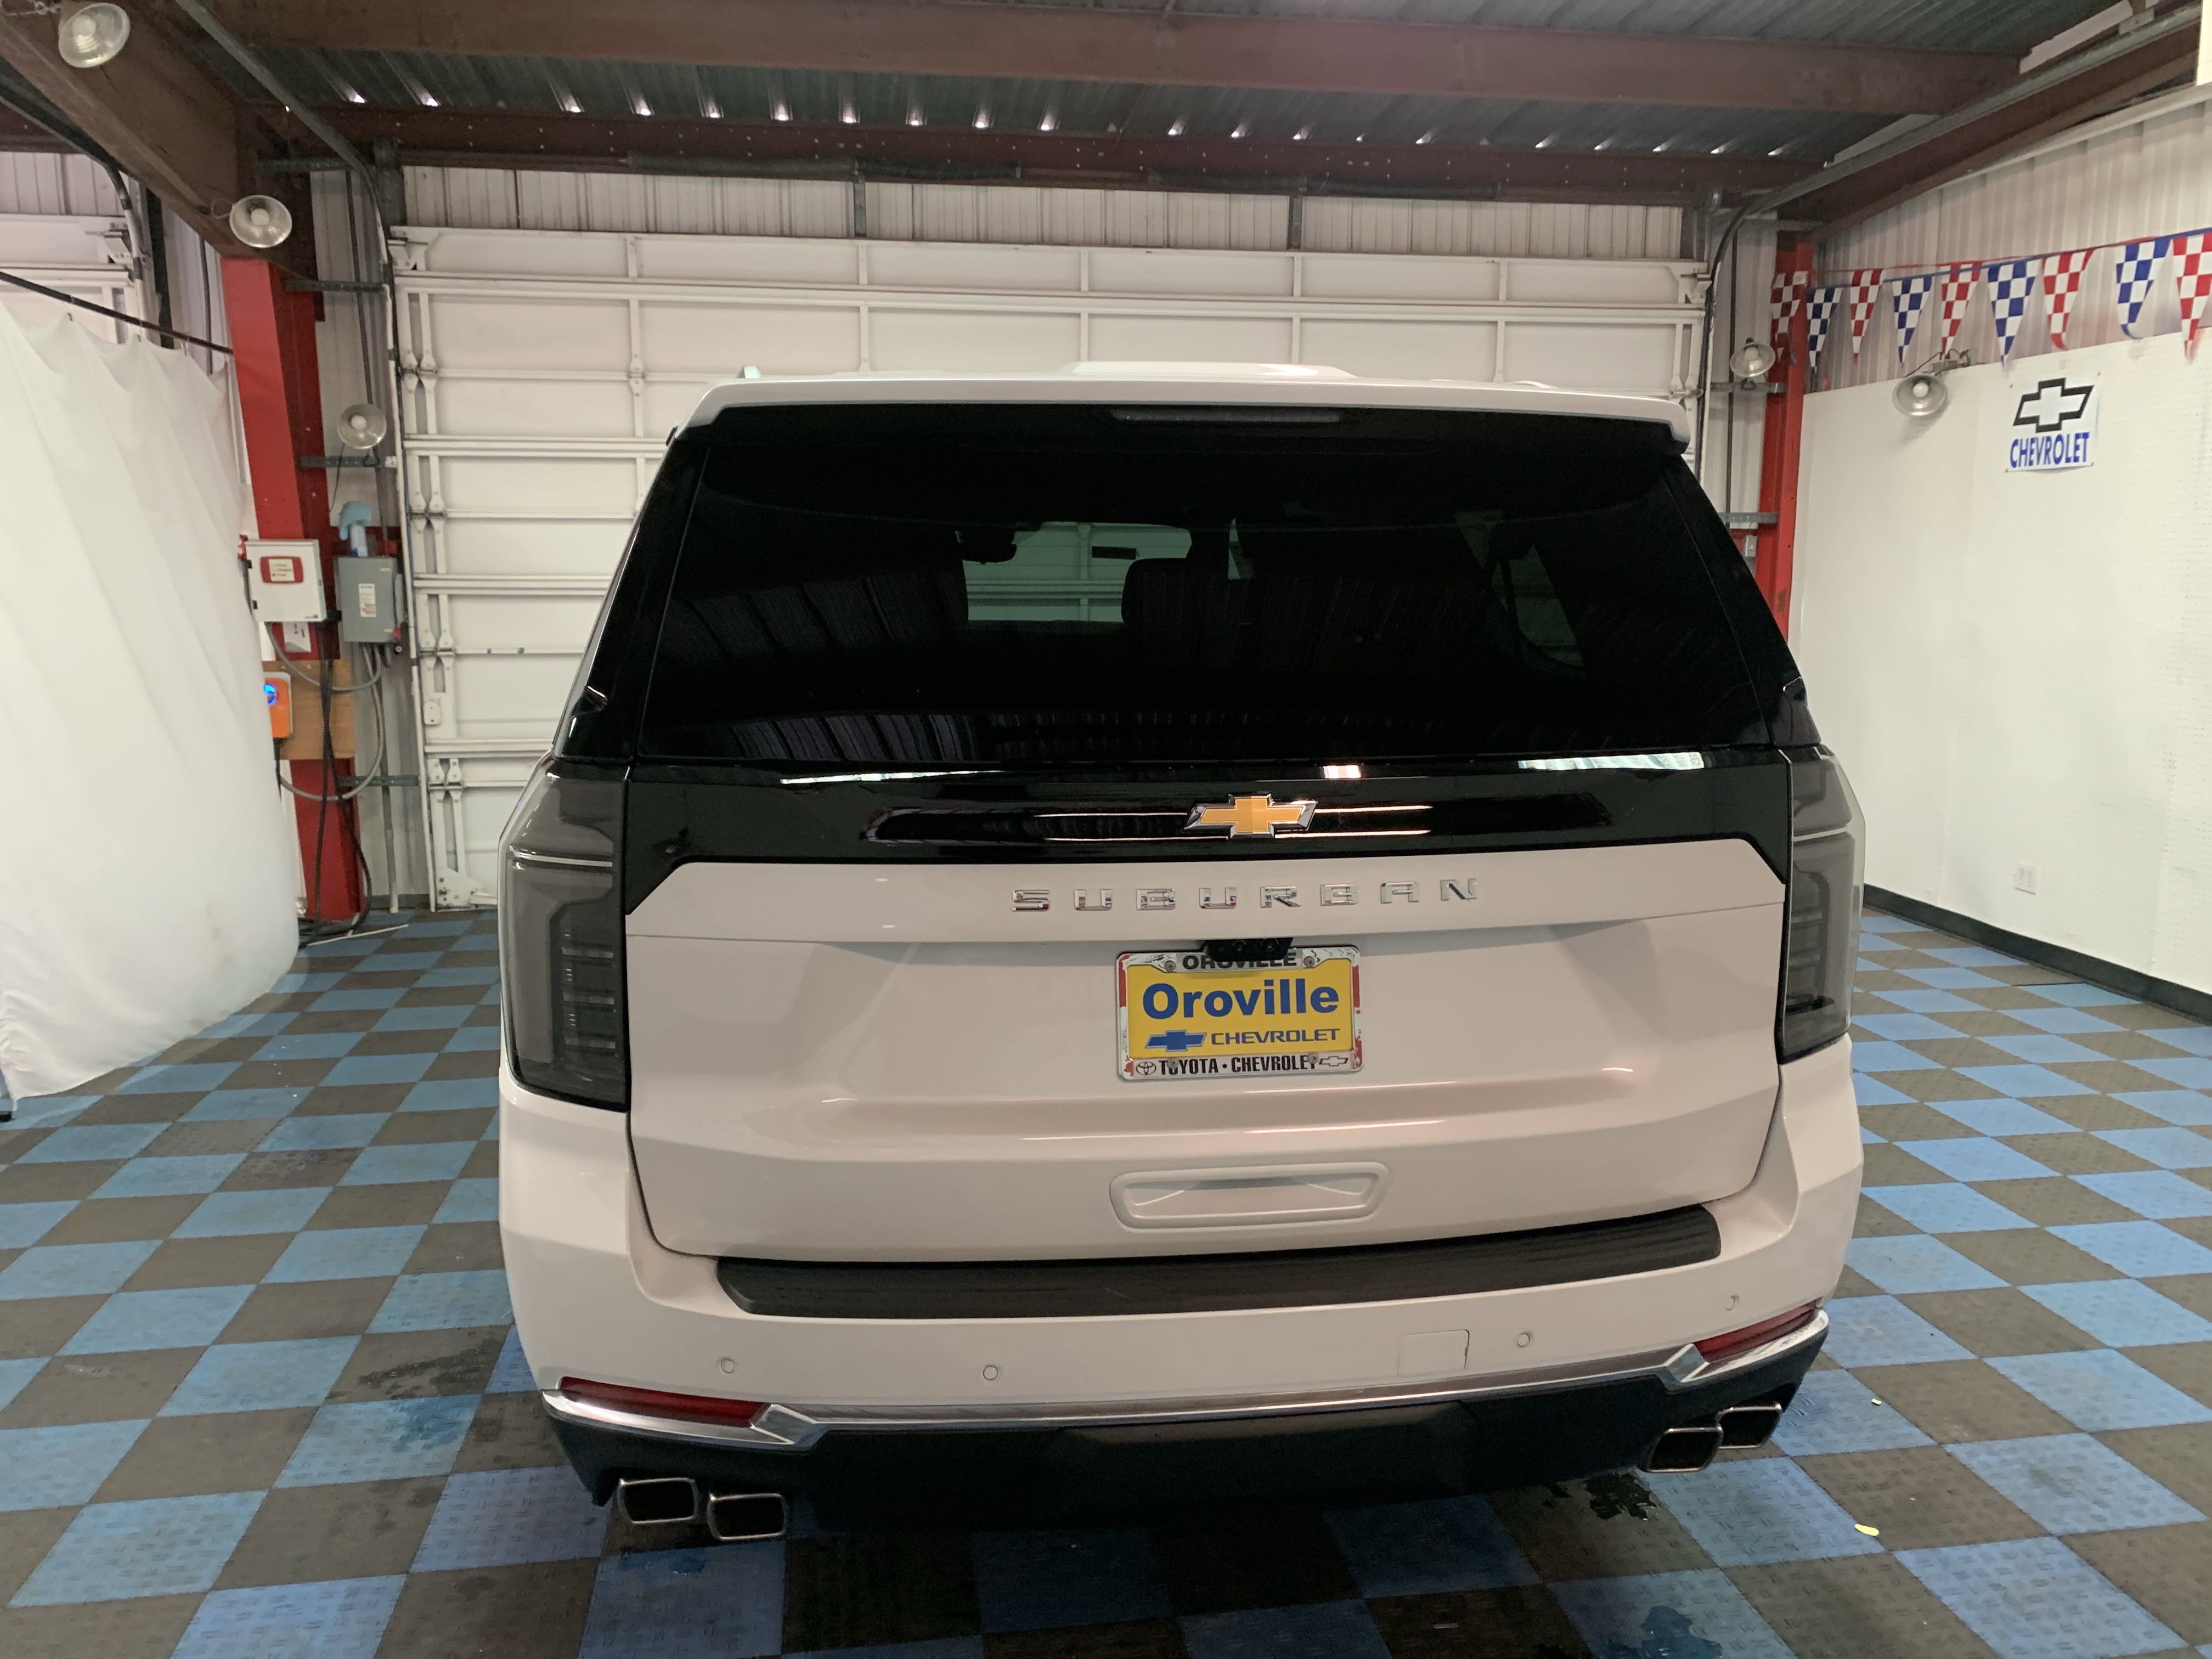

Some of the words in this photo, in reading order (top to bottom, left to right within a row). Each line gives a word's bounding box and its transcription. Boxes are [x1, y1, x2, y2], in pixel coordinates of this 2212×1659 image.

[2010, 432, 2090, 468] CHEVROLET
[1011, 878, 1477, 912] SUBURBAN
[1142, 978, 1339, 1019] Oroville
[1211, 1028, 1340, 1045] CHEVROLET
[1159, 1058, 1218, 1075] TOYOTA
